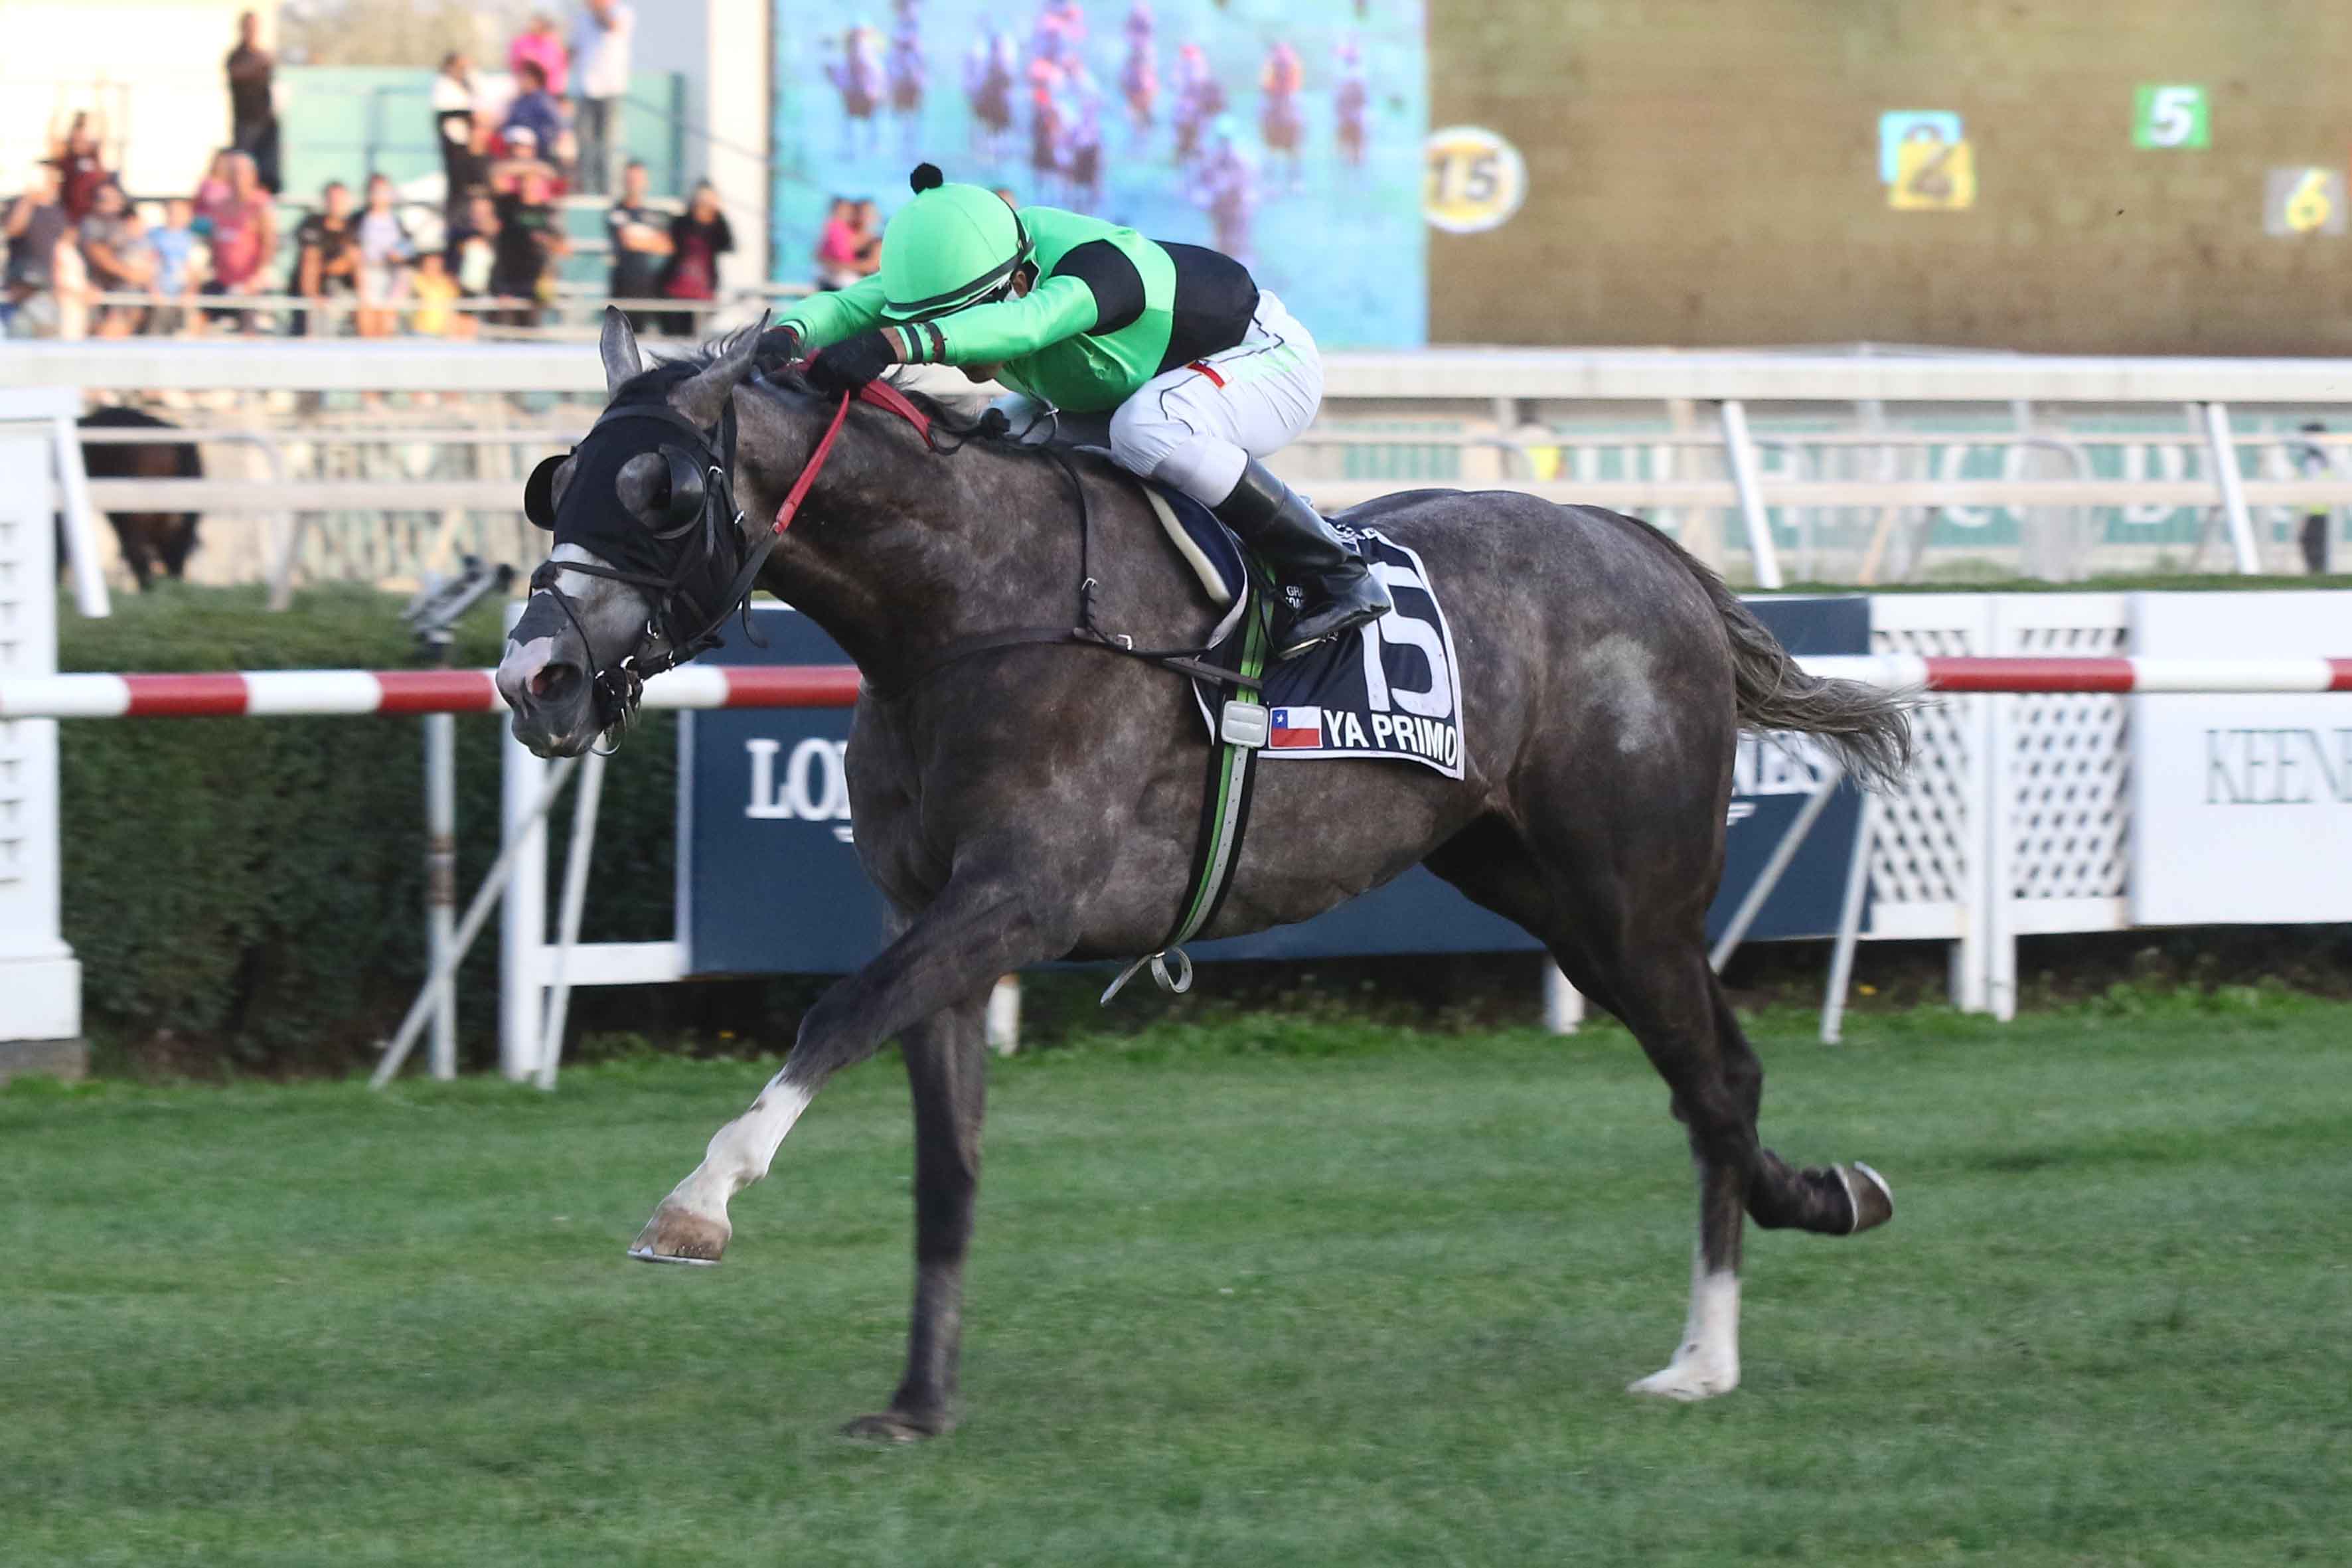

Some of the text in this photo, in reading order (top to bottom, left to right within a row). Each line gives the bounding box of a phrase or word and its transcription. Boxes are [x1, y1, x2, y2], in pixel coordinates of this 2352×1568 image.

[2150, 86, 2199, 147] 5
[1431, 151, 1498, 201] 15
[2284, 167, 2330, 232] 6
[1323, 709, 1458, 767] YA PRIMO
